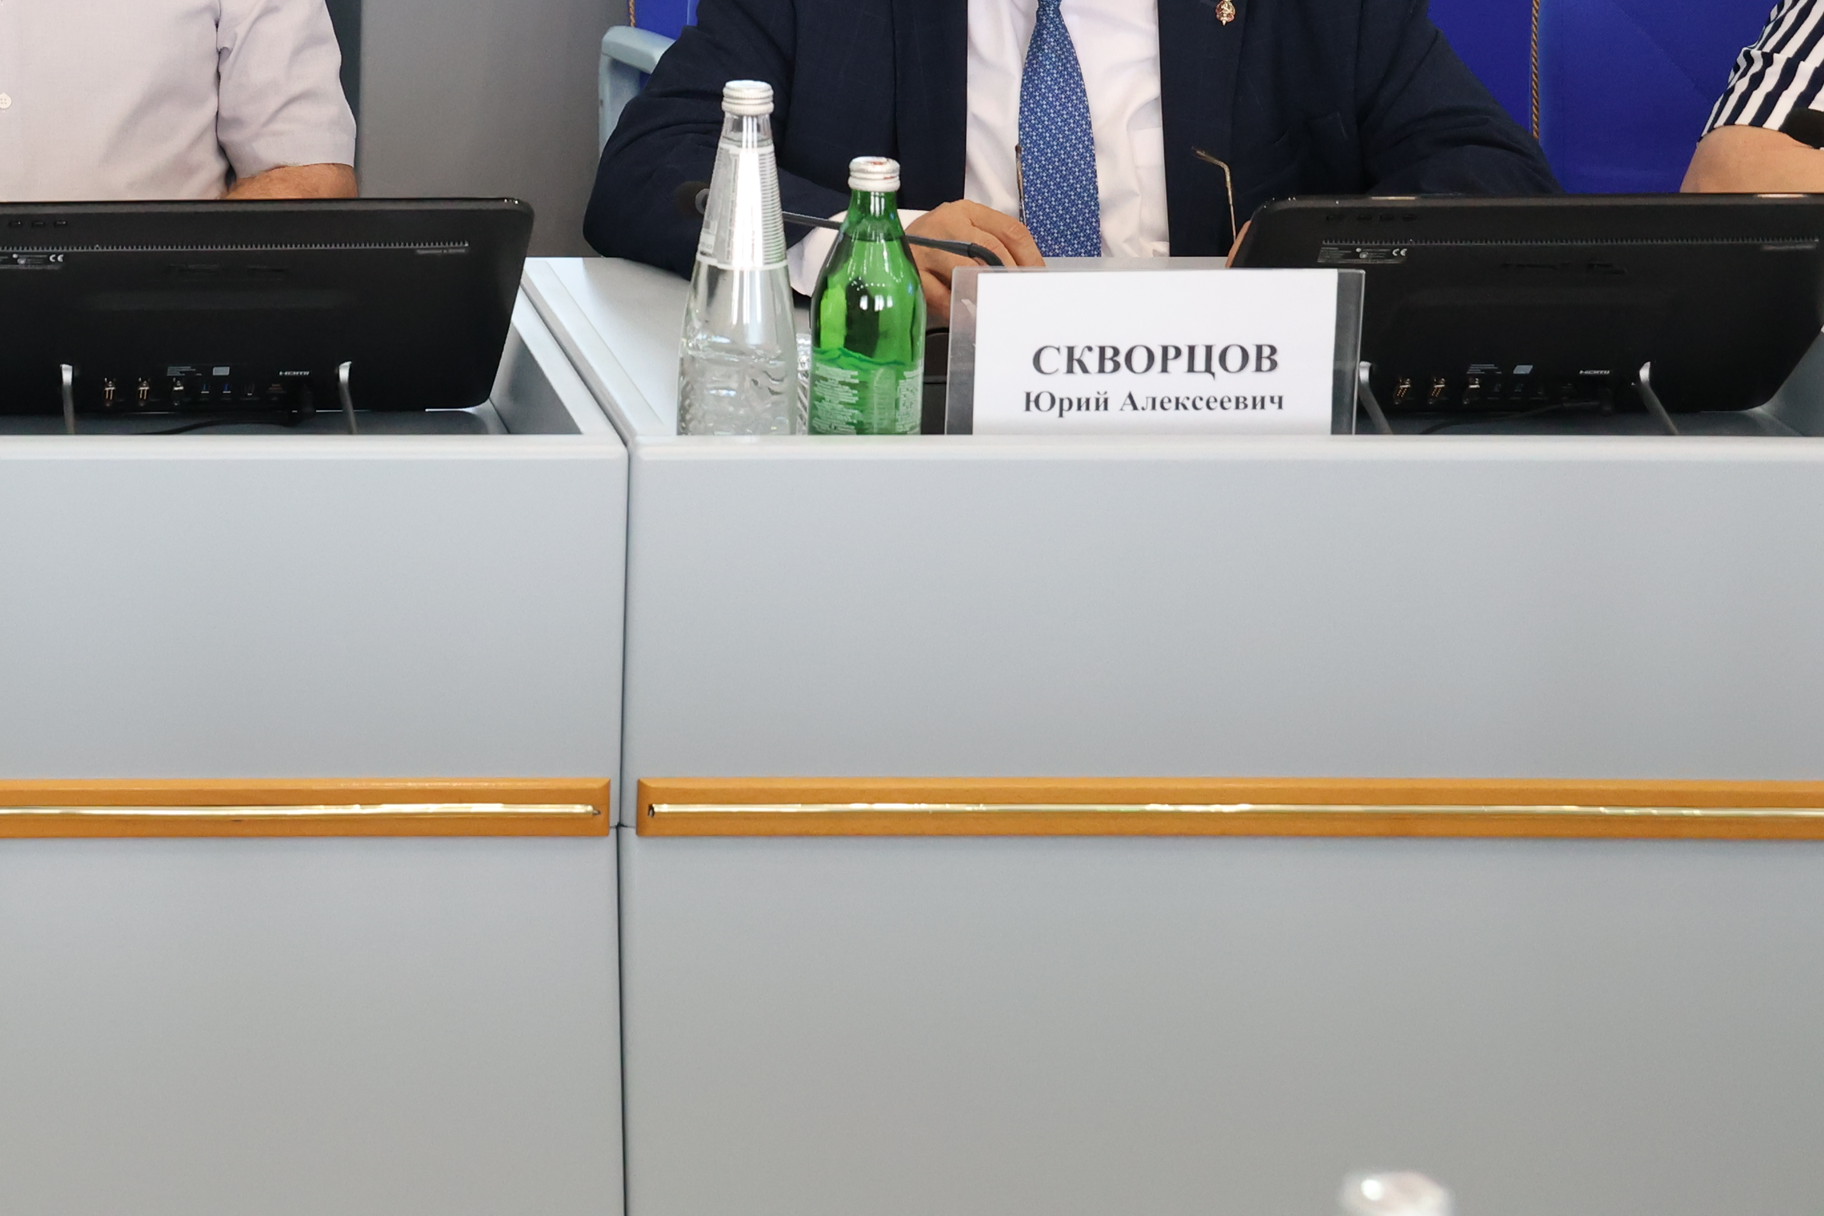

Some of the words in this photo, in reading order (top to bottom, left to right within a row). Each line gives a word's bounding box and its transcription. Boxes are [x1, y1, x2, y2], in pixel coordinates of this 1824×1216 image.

[1031, 343, 1279, 381] СКВОРЦОВ
[1023, 390, 1109, 418] Юрий
[1119, 391, 1285, 412] Алексеевич
